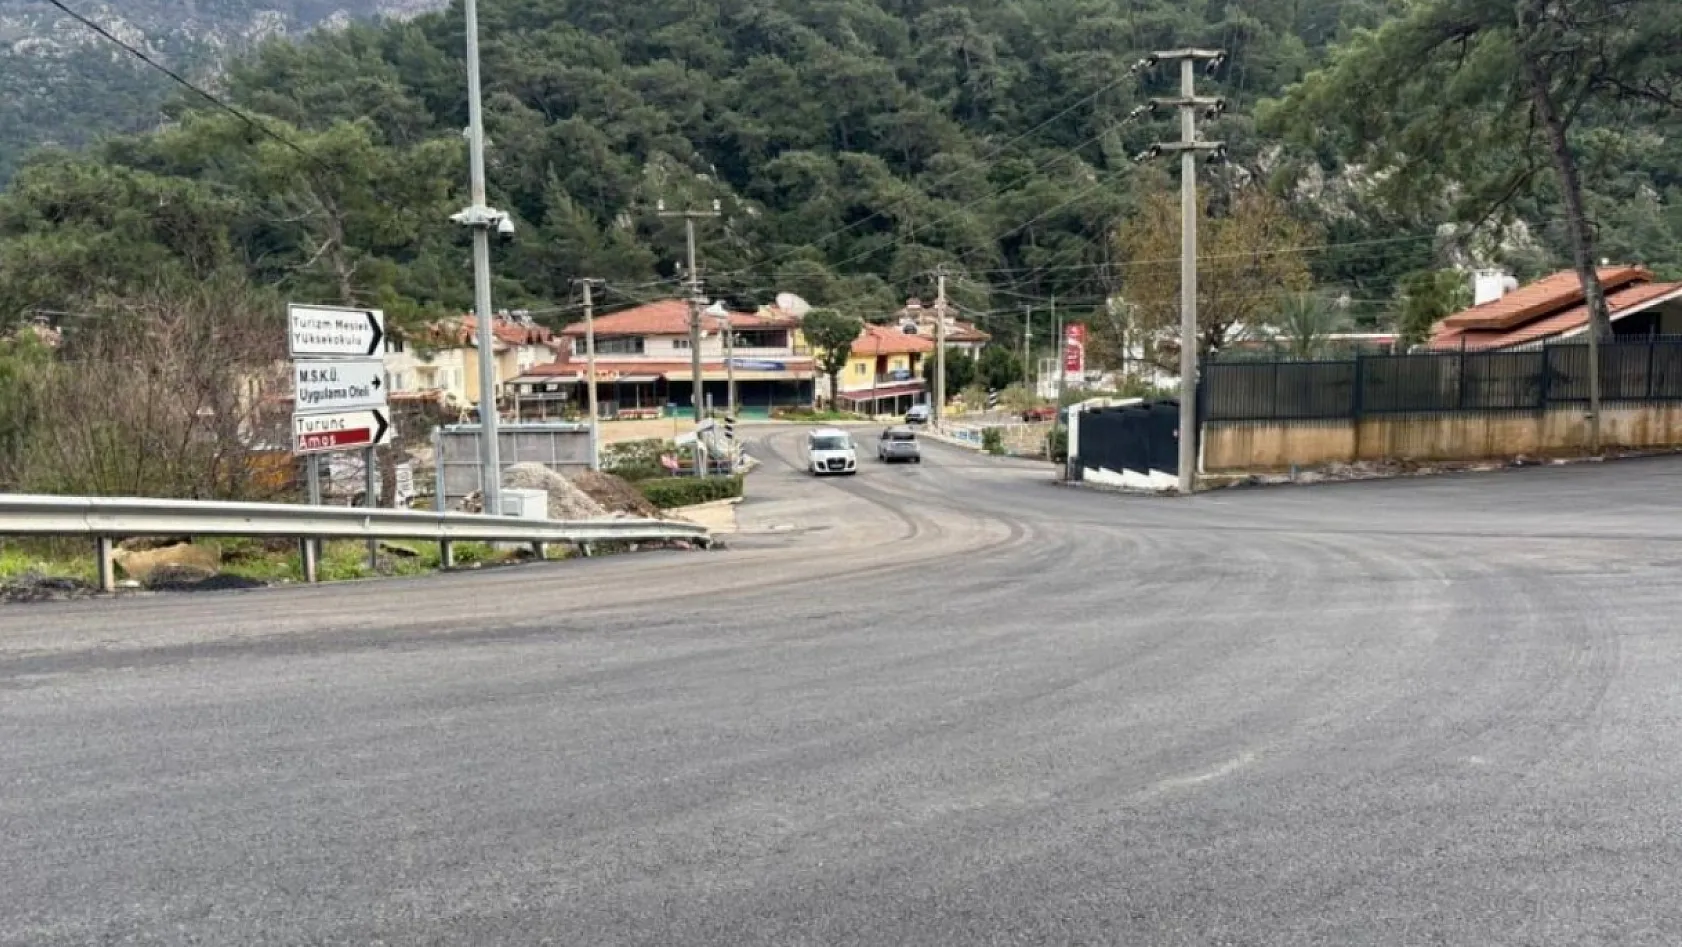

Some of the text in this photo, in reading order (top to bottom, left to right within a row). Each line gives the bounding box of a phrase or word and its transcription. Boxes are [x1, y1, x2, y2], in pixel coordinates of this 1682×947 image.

[293, 316, 331, 330] Turizm
[294, 333, 362, 345] Yüksekokulu
[299, 384, 370, 404] Uygulama Oteli
[299, 434, 336, 449] Amos
